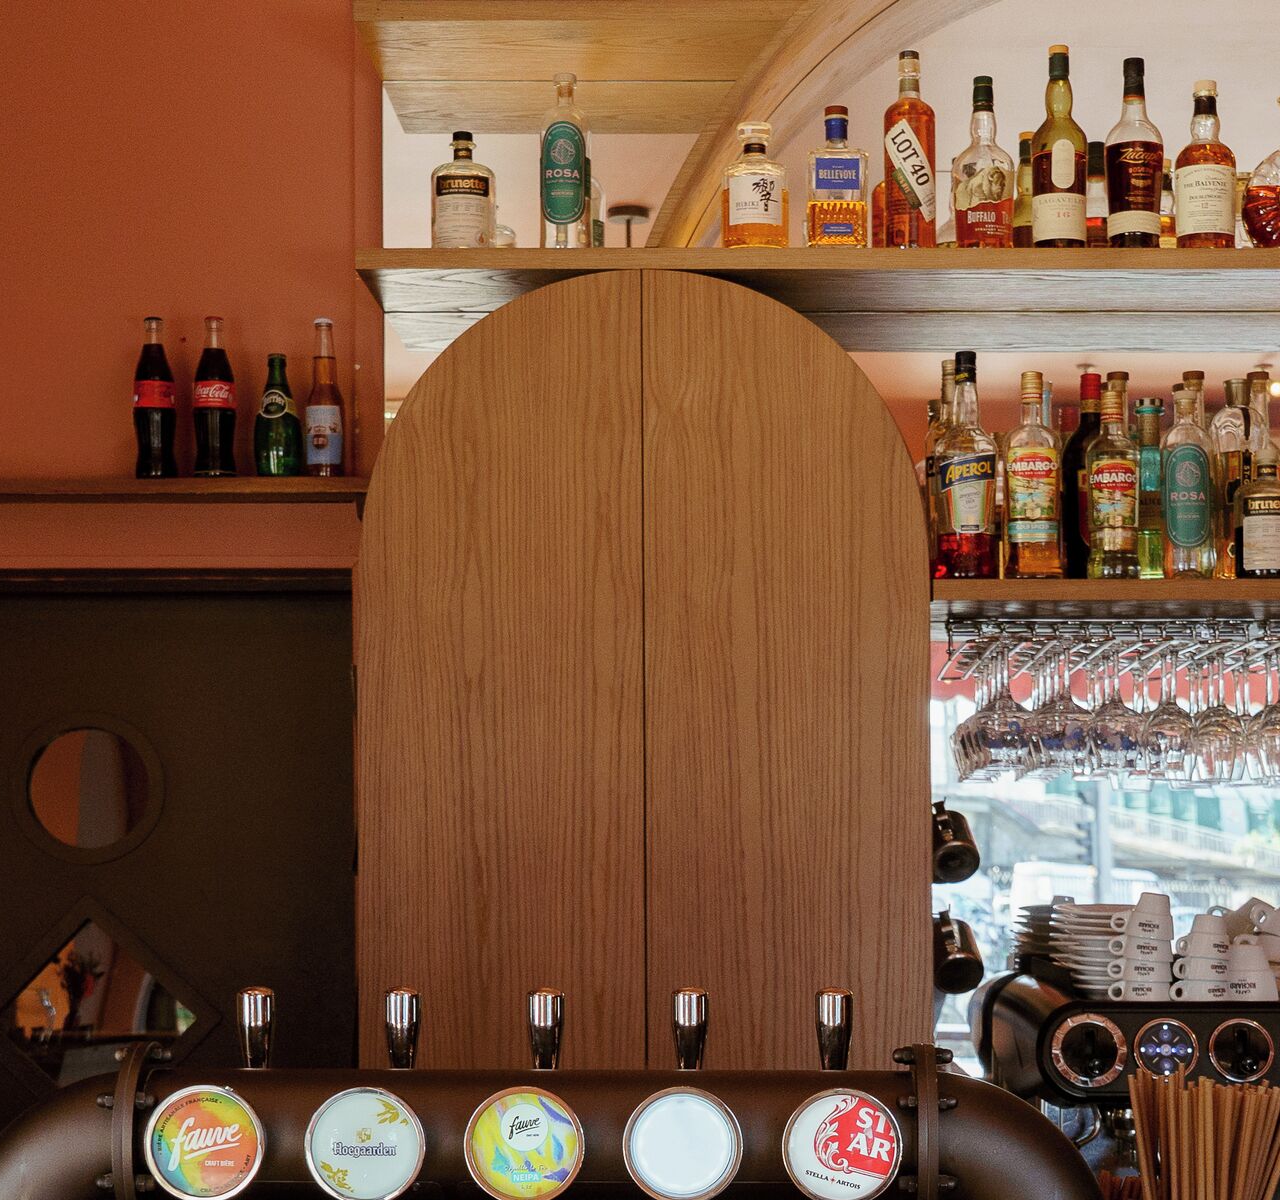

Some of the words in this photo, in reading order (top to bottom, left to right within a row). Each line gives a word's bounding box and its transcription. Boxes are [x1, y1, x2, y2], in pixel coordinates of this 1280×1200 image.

[891, 129, 919, 162] LOT
[910, 163, 930, 186] 40
[546, 169, 580, 179] ROSA
[818, 170, 857, 180] BELLEVOYE
[1195, 180, 1227, 188] BALVENIE
[753, 178, 778, 212] 響
[967, 211, 996, 224] BUFFALO
[946, 461, 992, 484] APEROL
[1006, 461, 1058, 471] EMBARGO
[1171, 492, 1206, 501] ROSA
[185, 1096, 219, 1107] FRANÇAISE
[508, 1116, 542, 1140] fauve
[856, 1107, 896, 1136] ST
[168, 1117, 242, 1172] fauve
[332, 1142, 397, 1158] Hoegaarden
[513, 1172, 539, 1182] NEIPA
[805, 1169, 829, 1181] STELLA
[836, 1180, 861, 1190] ARTOIS
